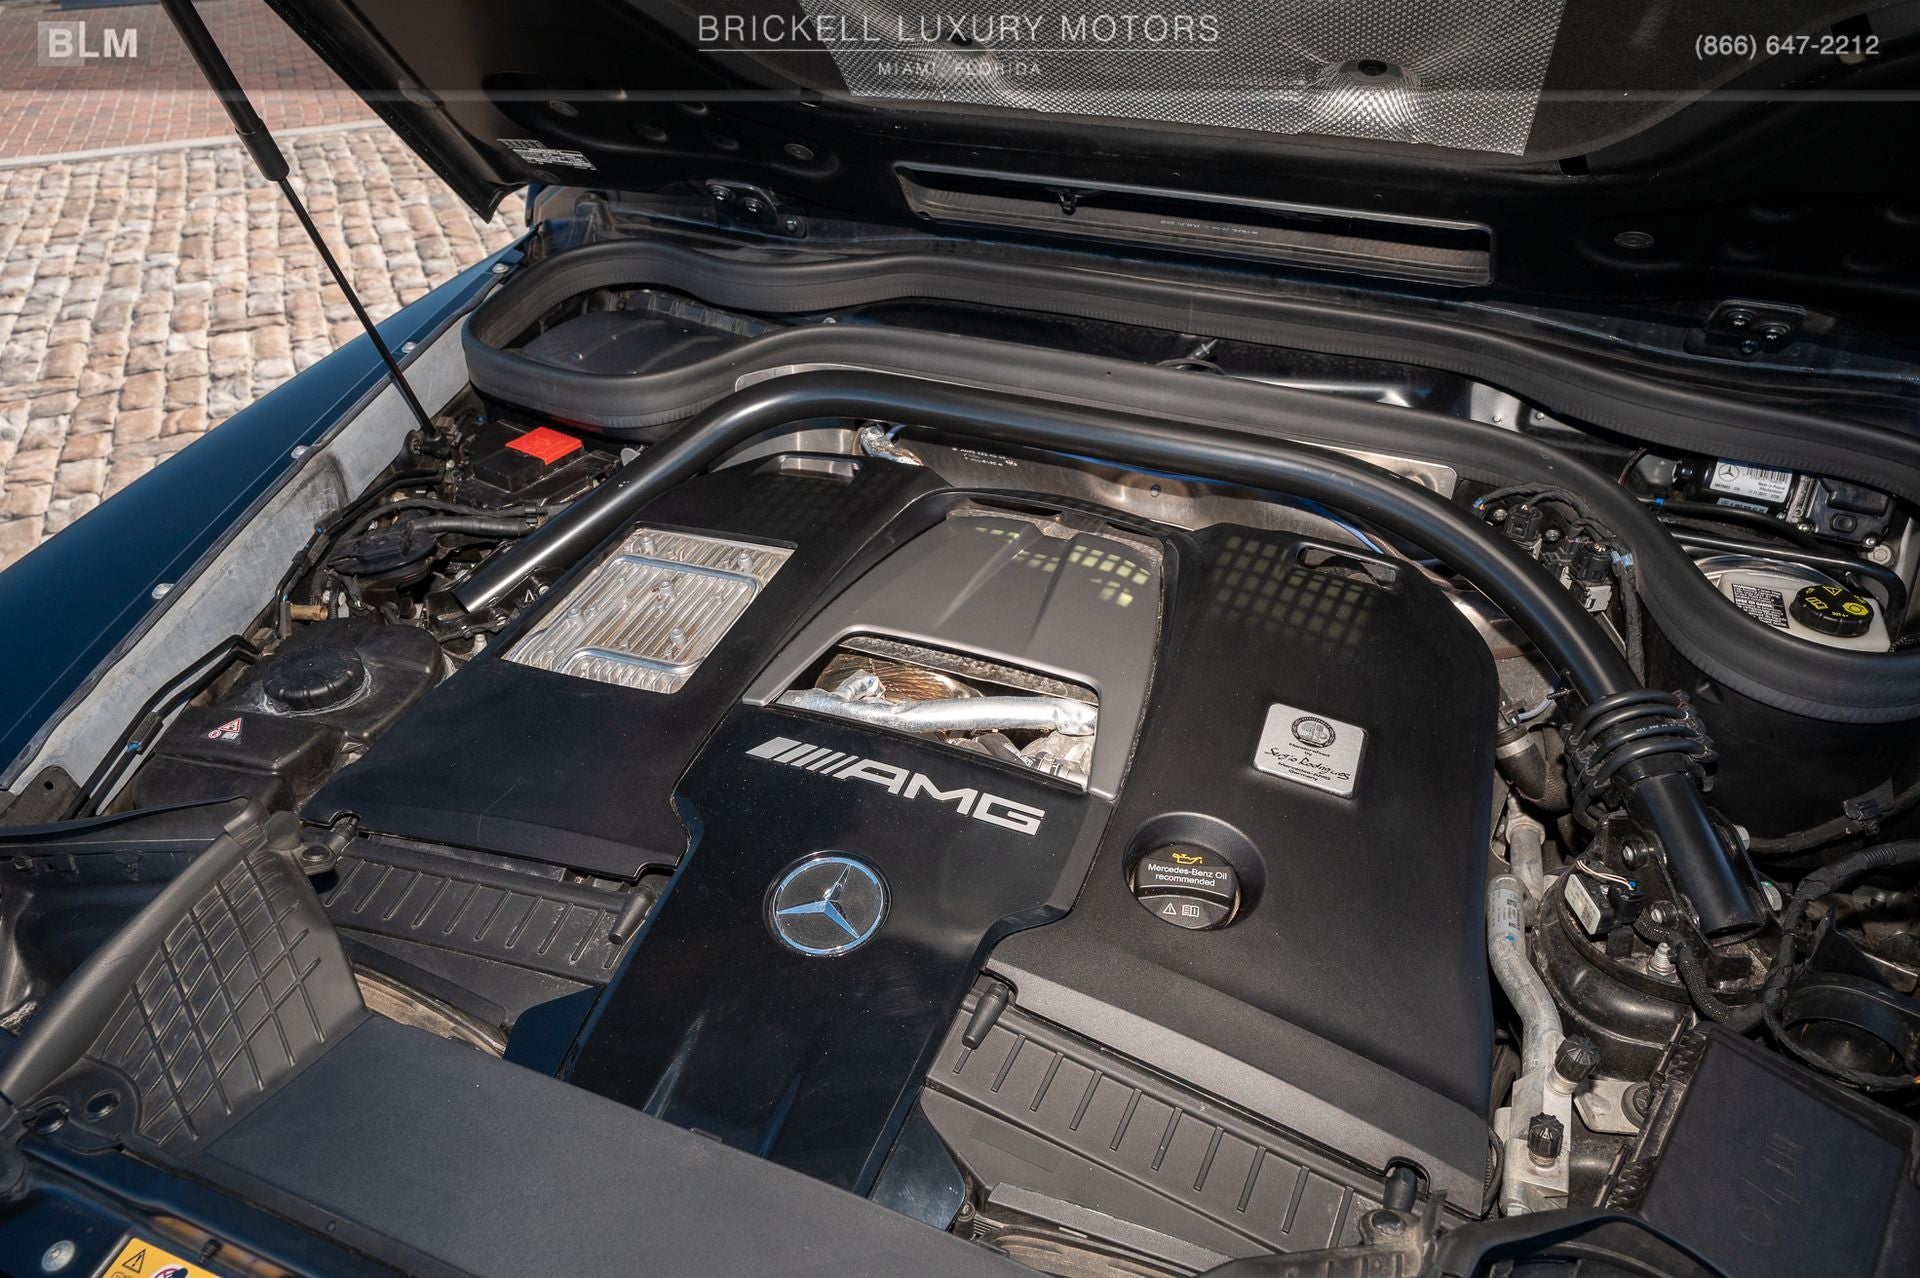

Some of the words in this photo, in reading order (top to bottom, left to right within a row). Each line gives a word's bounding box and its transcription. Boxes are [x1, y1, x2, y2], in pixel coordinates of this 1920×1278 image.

[831, 758, 1046, 836] AMG
[1148, 863, 1213, 877] Mercedes-Benz
[1215, 871, 1227, 880] Oil
[1155, 873, 1215, 886] recommended
